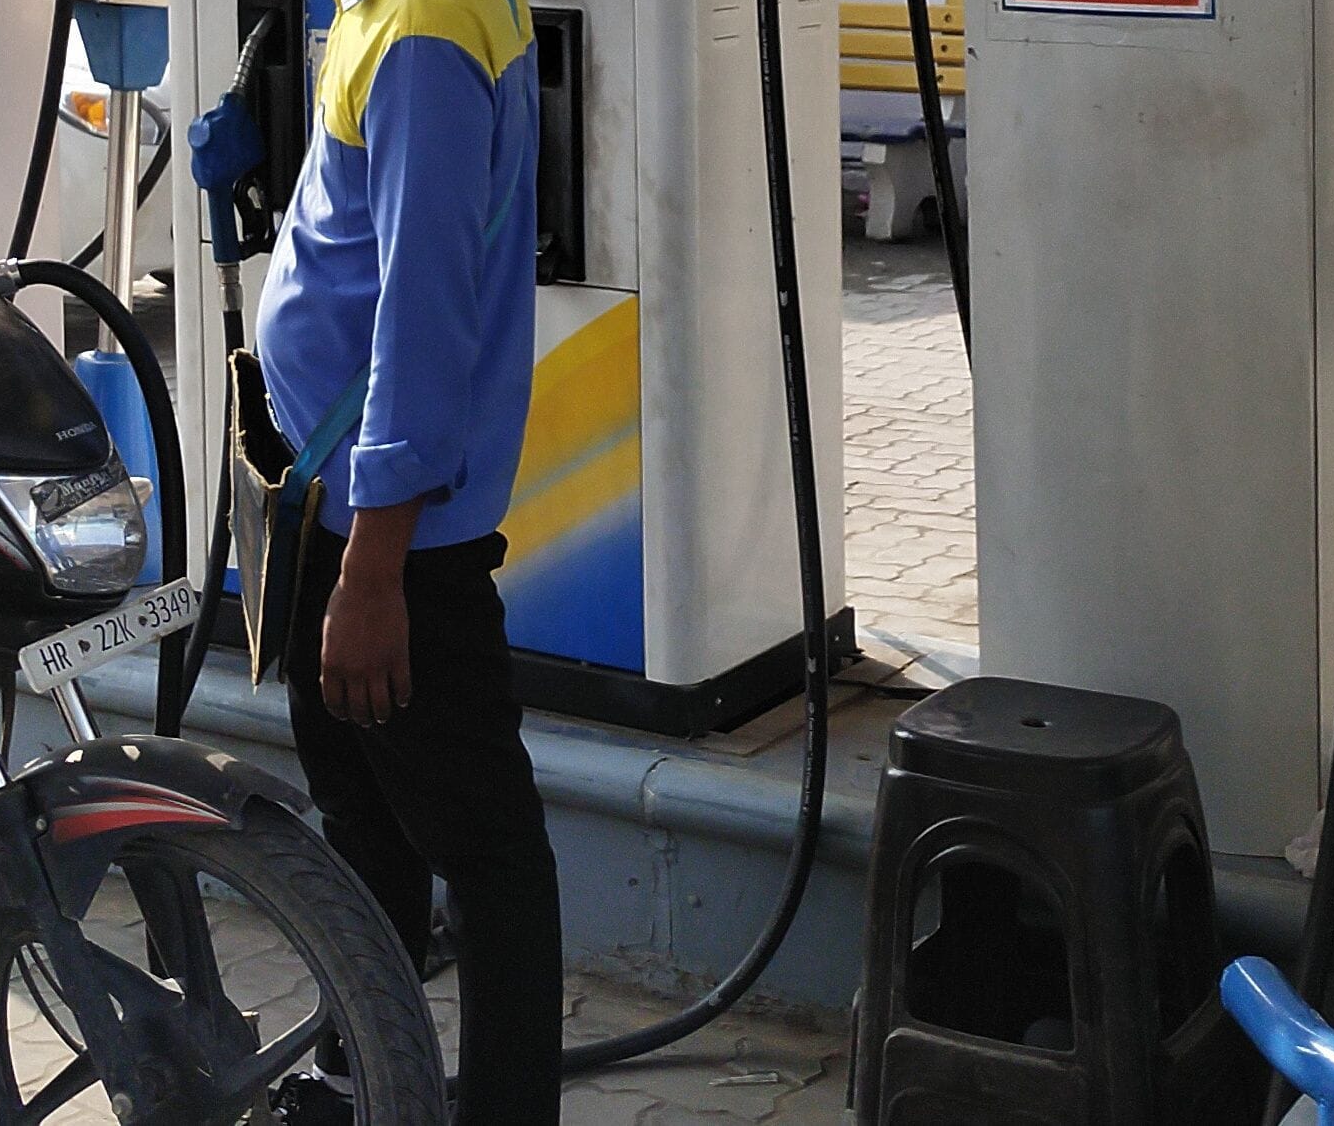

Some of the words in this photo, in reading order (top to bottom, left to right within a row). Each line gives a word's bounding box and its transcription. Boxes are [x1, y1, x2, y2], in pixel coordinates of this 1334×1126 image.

[54, 420, 98, 442] HONDA
[39, 640, 73, 676] HR
[92, 613, 137, 653] 22K
[144, 587, 192, 629] 3349
